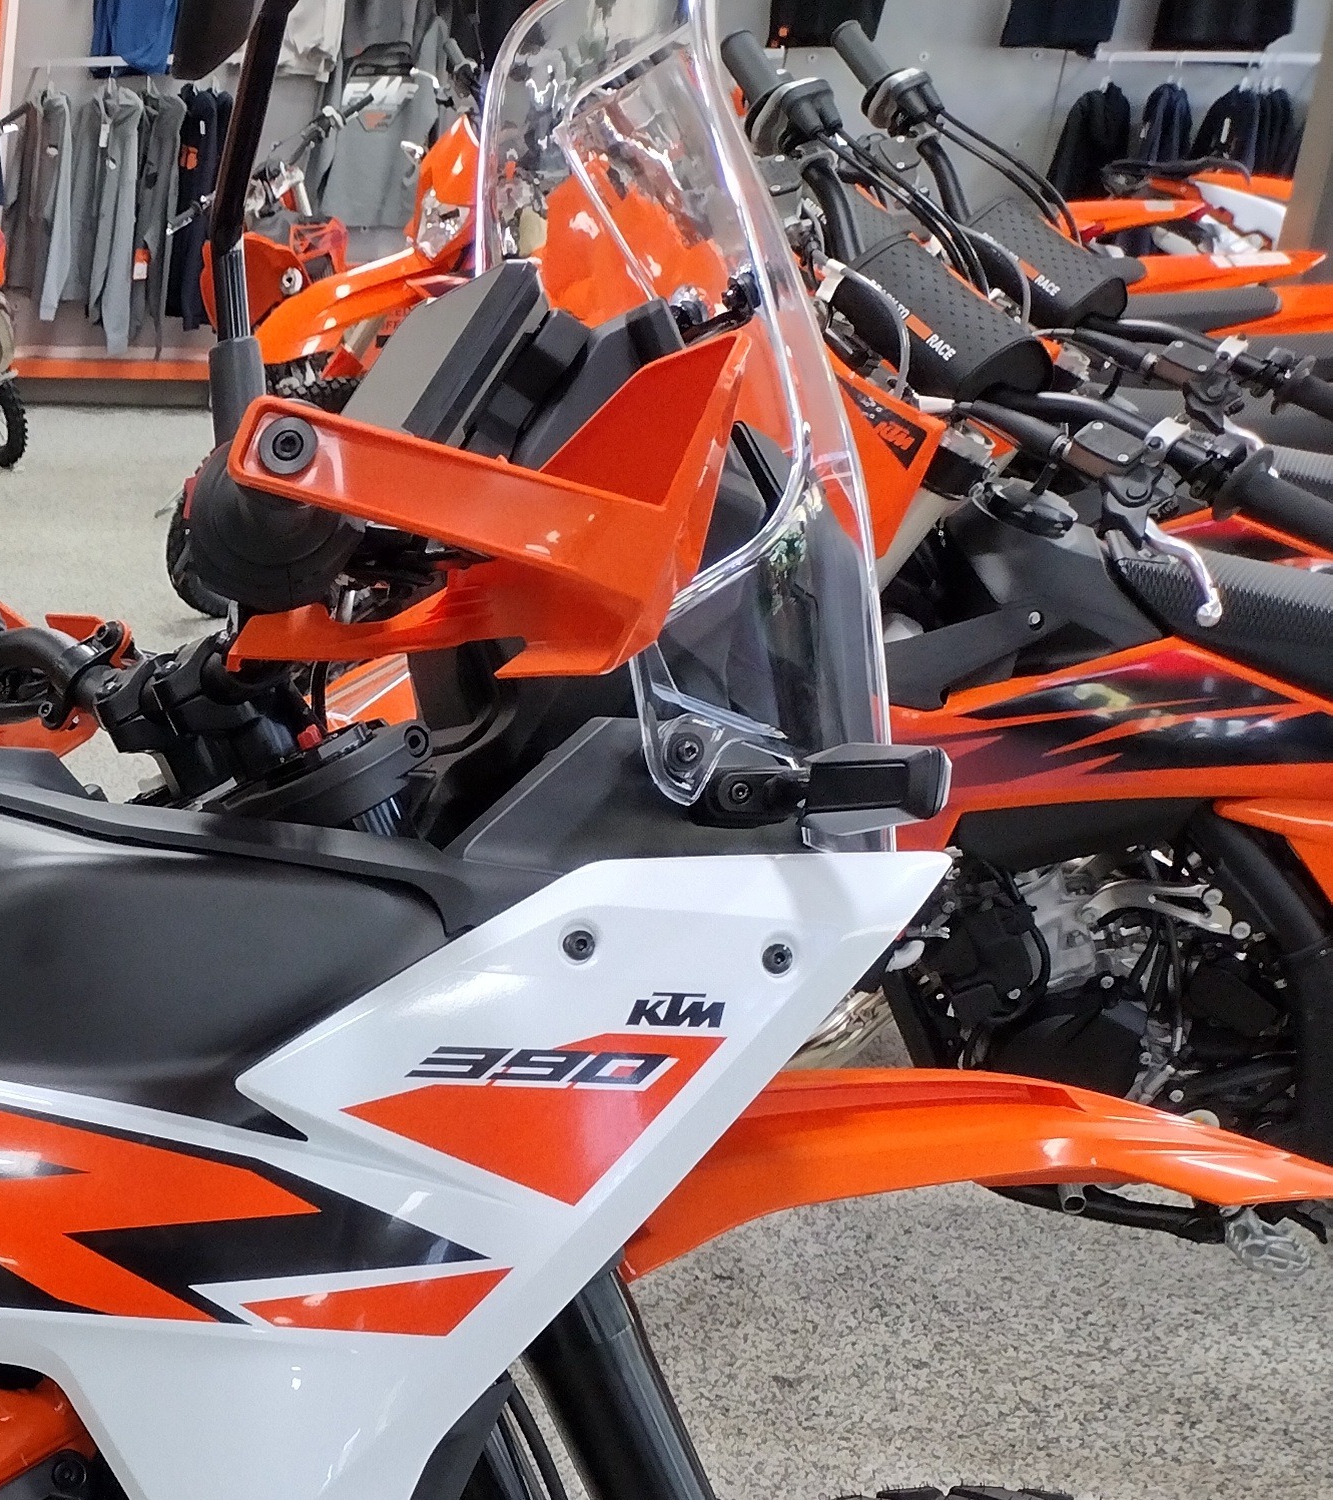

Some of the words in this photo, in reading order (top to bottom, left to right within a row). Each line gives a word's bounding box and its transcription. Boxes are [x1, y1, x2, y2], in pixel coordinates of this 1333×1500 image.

[1034, 274, 1061, 297] RACE
[925, 333, 957, 361] RACE
[625, 992, 725, 1028] KTM
[403, 1046, 671, 1087] 390
